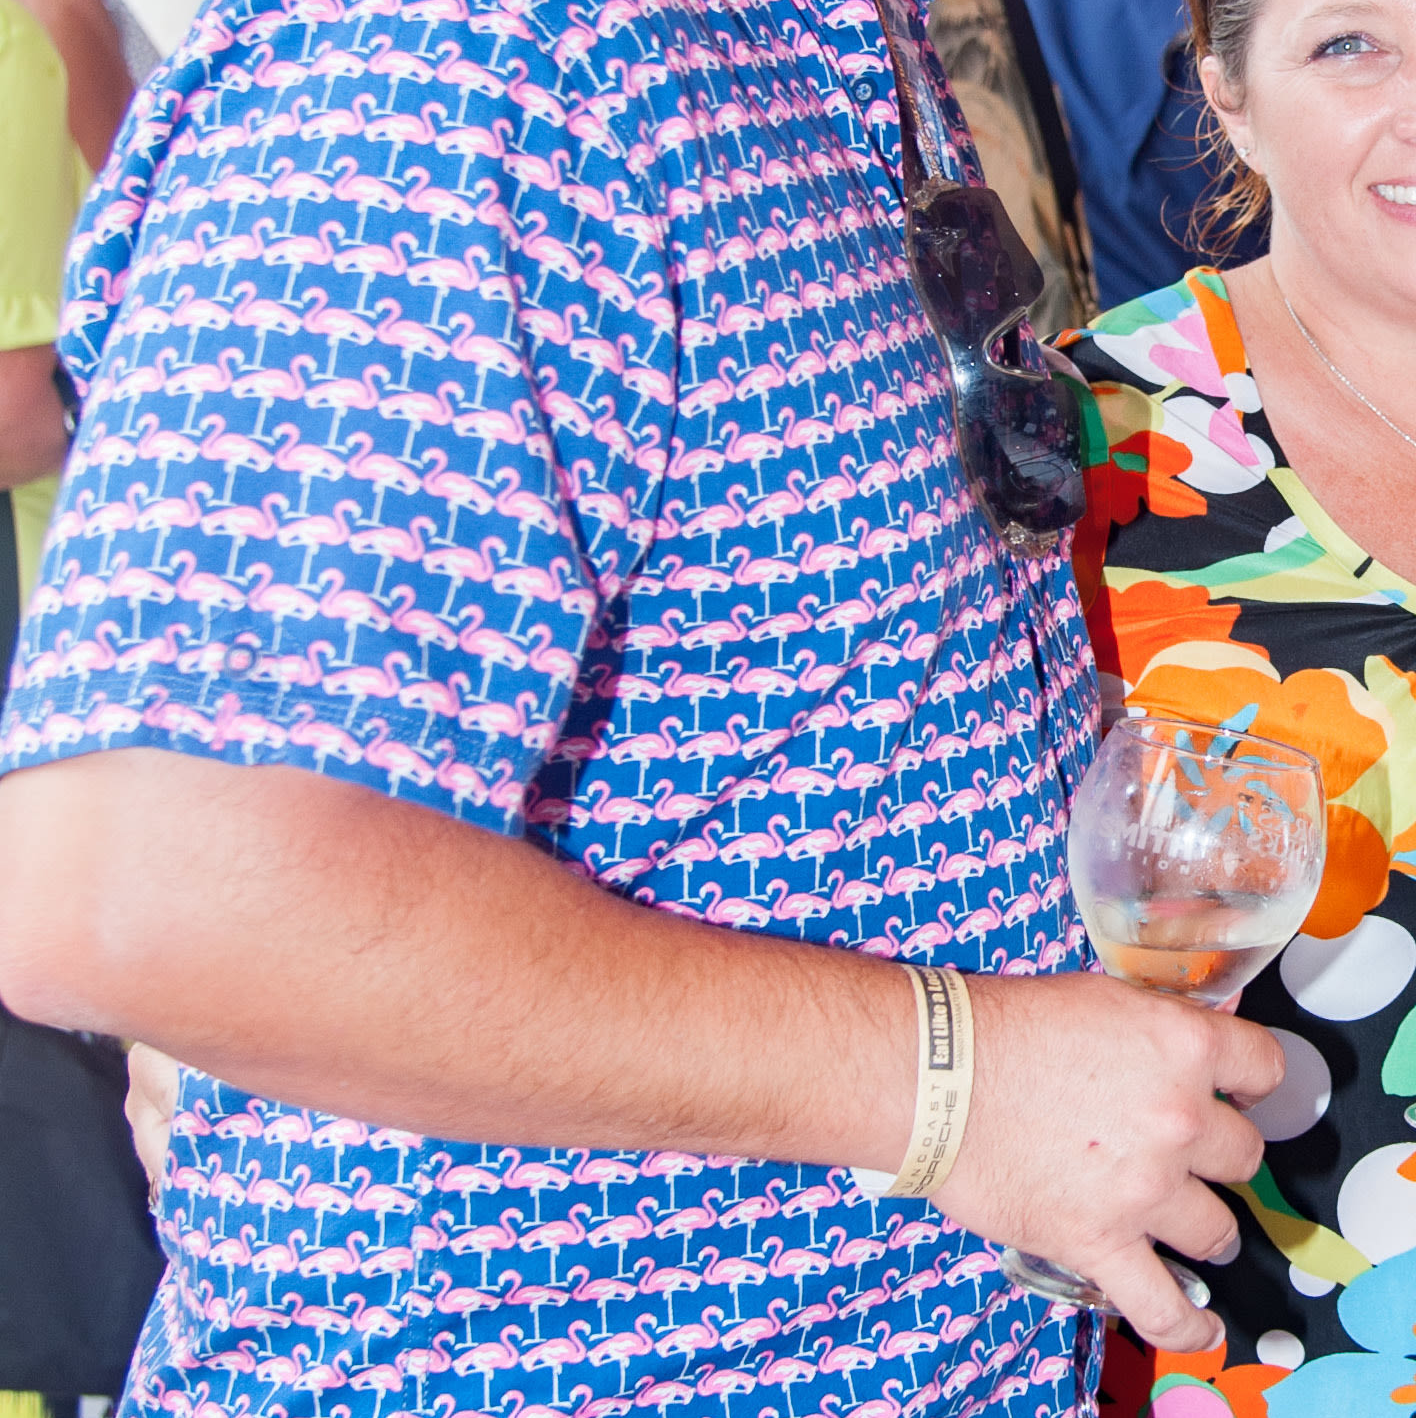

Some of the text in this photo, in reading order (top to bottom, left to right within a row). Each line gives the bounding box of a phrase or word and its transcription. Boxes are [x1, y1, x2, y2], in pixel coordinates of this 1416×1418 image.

[931, 992, 946, 1003] a
[931, 1005, 949, 1037] Like
[932, 1038, 949, 1065] Eat
[911, 1090, 957, 1195] PORSCHE
